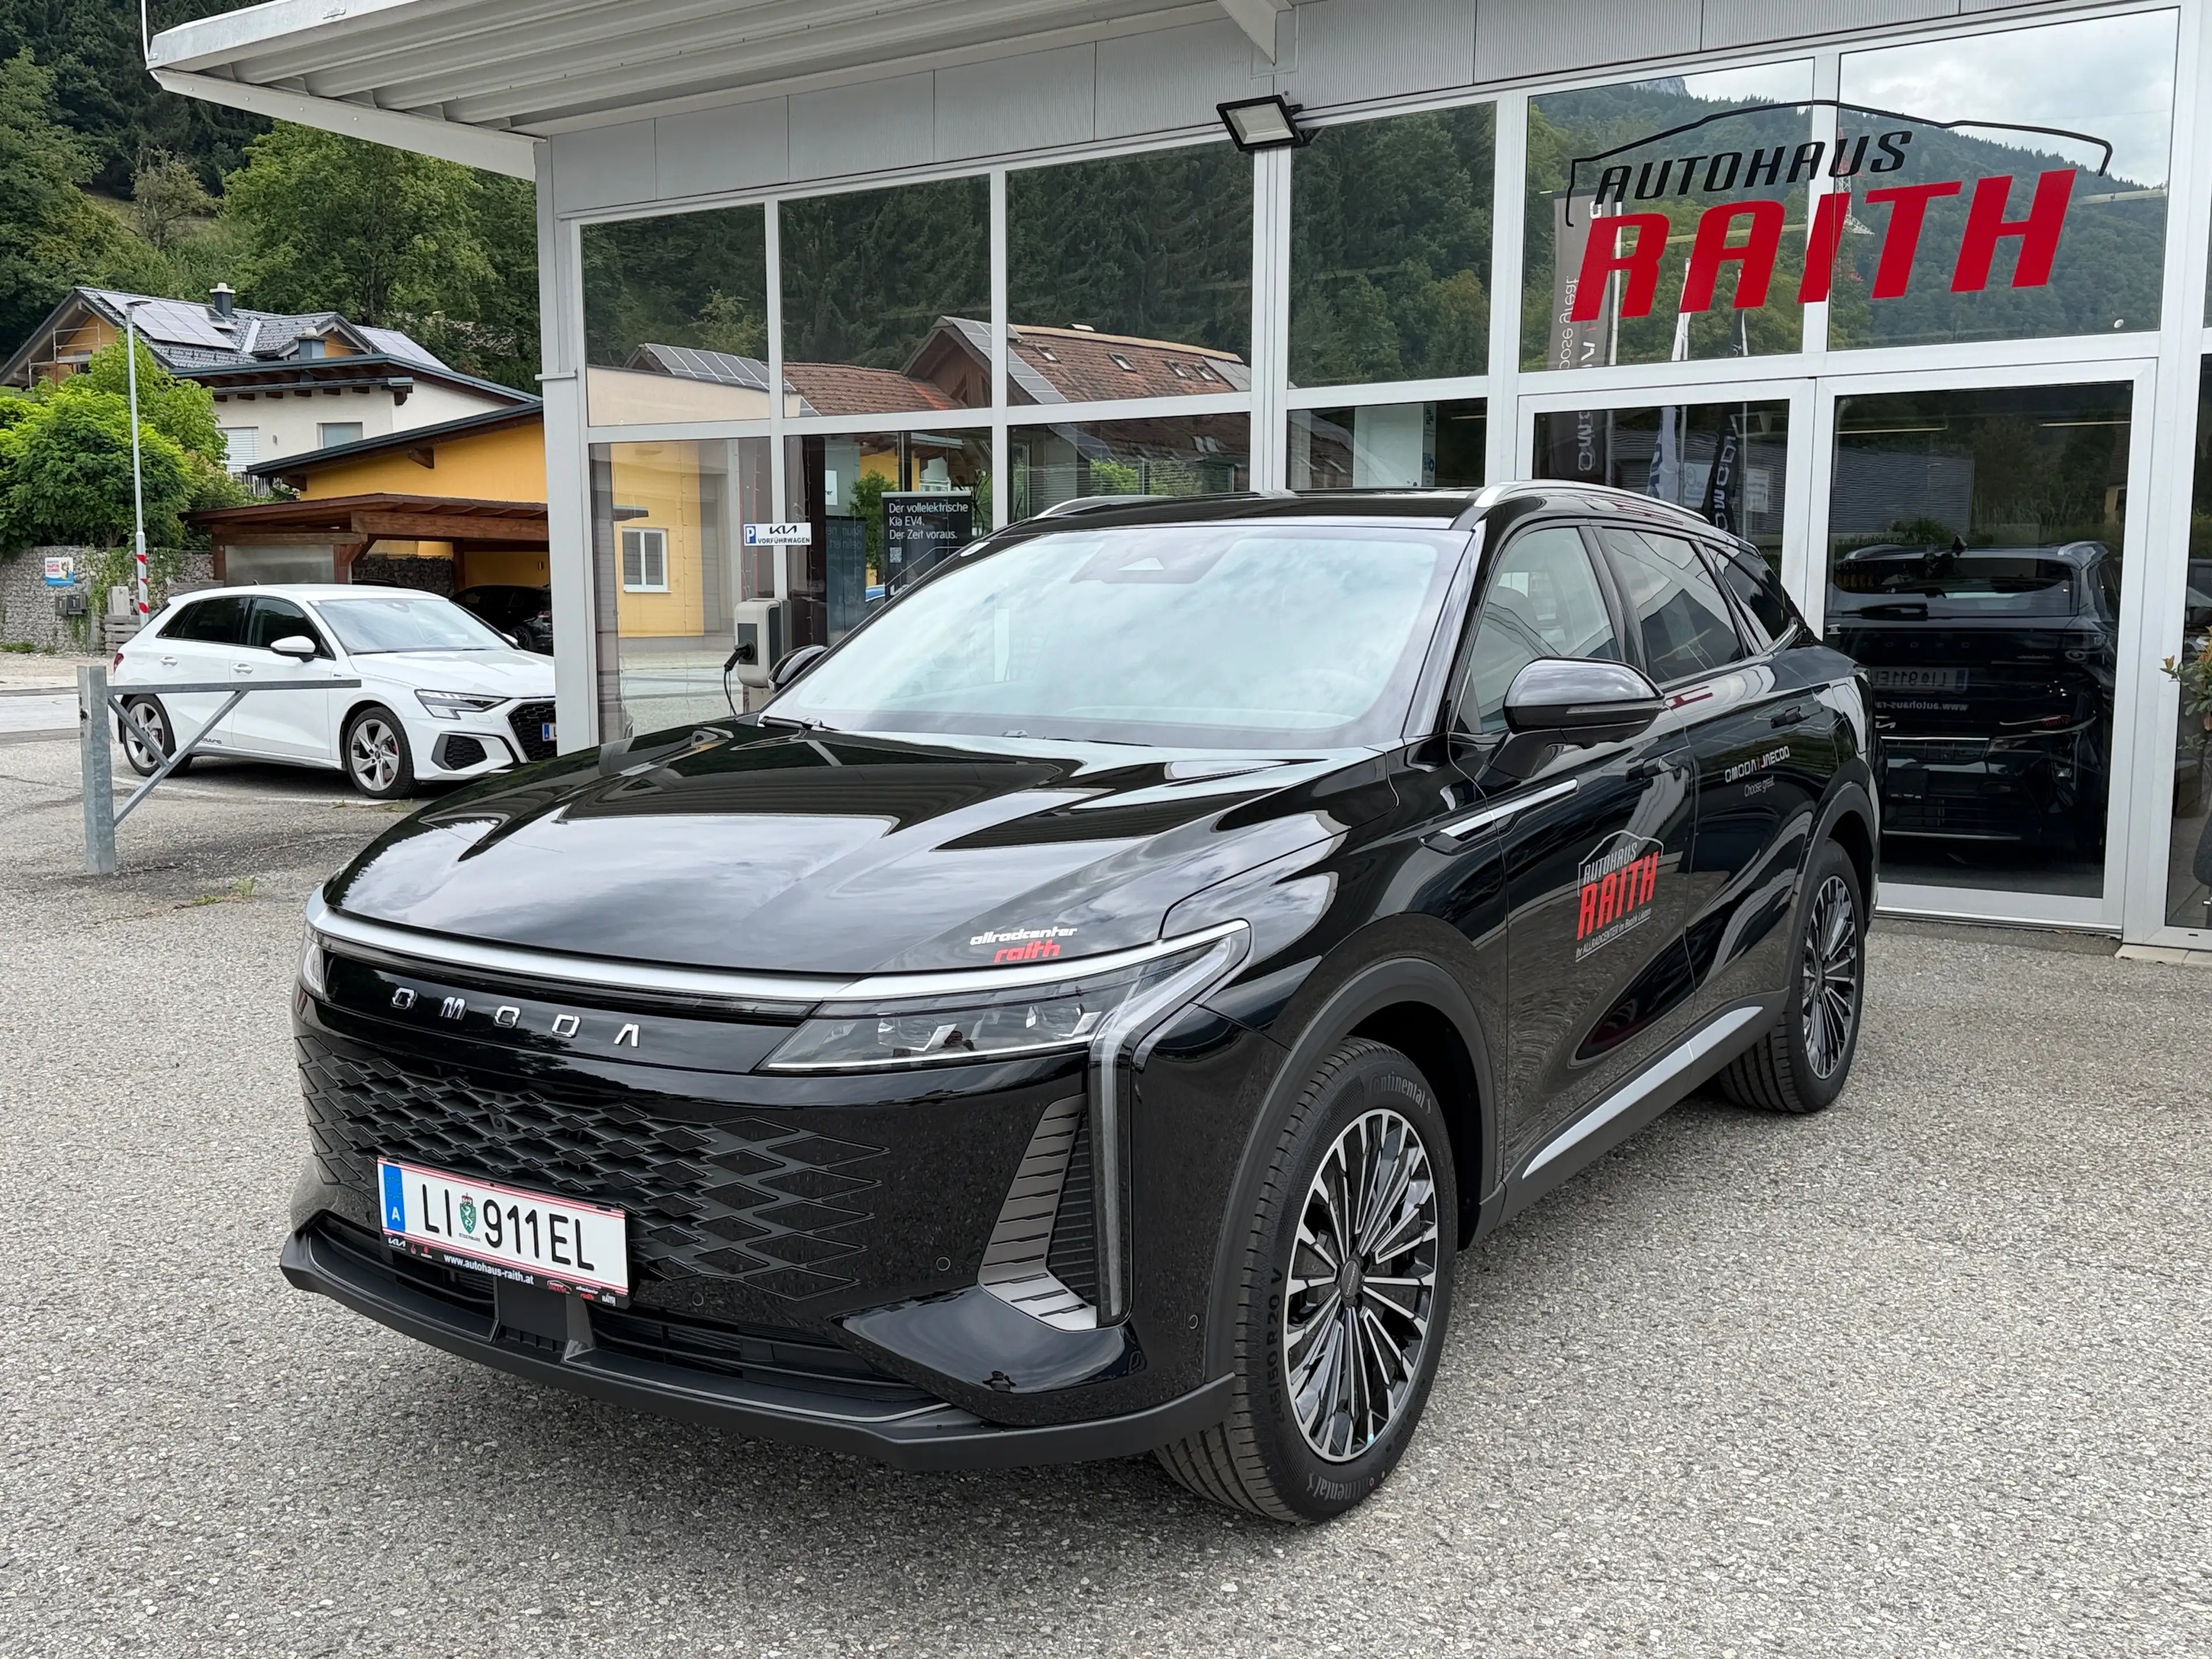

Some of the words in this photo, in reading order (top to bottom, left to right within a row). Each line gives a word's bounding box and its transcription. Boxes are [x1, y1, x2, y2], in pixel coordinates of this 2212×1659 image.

[1594, 130, 1914, 205] AUTOHAUS
[1570, 168, 2077, 323] RAITH
[889, 503, 905, 513] Der
[907, 502, 969, 513] vollelektrische
[746, 527, 755, 543] P
[770, 525, 797, 534] KIA
[889, 517, 903, 527] Kia
[904, 516, 925, 527] EV4.
[889, 529, 905, 540] Der
[907, 529, 924, 539] Zeit
[926, 530, 958, 540] voraus.
[1583, 841, 1638, 885] AUTOHAUS
[1577, 851, 1659, 941] RAITH
[969, 926, 1078, 945] allradcenter
[994, 940, 1061, 963] raith
[391, 1206, 401, 1222] A
[422, 1183, 453, 1238] LI
[483, 1198, 595, 1272] 911EL
[443, 1254, 535, 1285] www.autohaus-raith.at
